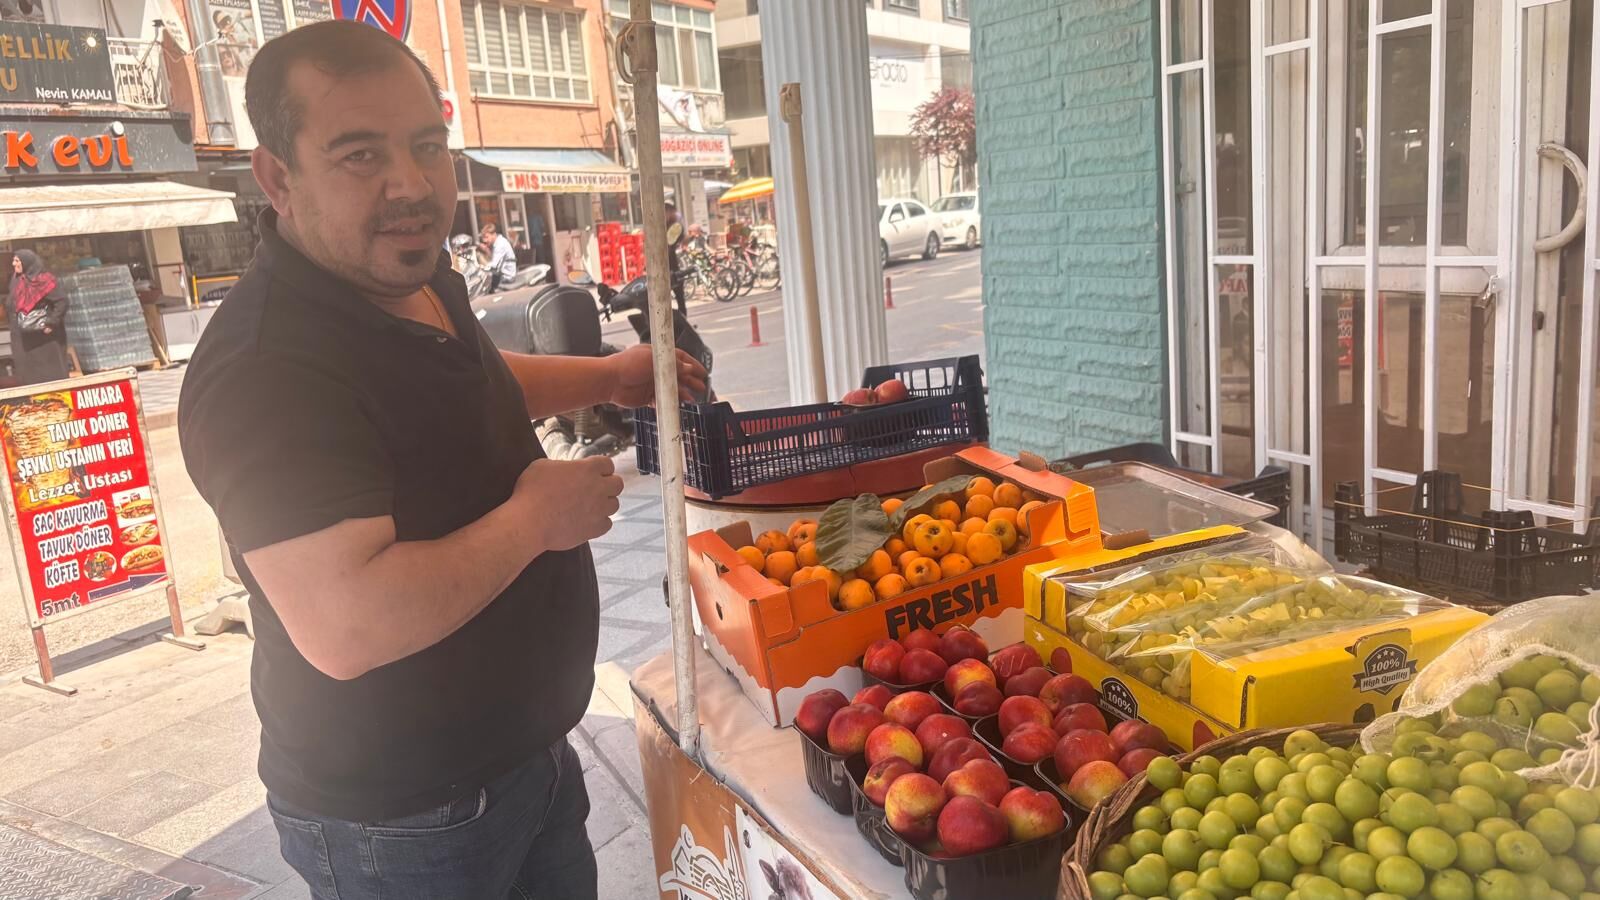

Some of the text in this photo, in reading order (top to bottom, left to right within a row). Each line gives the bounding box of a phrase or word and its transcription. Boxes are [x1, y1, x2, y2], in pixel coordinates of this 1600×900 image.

[35, 87, 113, 101] Nevin KAMALI
[77, 385, 124, 409] ANKARA
[47, 411, 129, 443] TAVUK DÖNER
[16, 433, 134, 483] ŞEVKİ USTANIN YERİ
[28, 469, 133, 503] Lezzet Ustası
[55, 500, 107, 527] KAVURMA
[39, 525, 112, 561] TAVUK DÖNER
[45, 560, 80, 588] KÖFTE
[41, 592, 81, 617] 5mt
[885, 574, 999, 640] FRESH
[1371, 657, 1400, 673] 100%
[1362, 670, 1408, 689] High Quality
[1107, 691, 1133, 714] 100%
